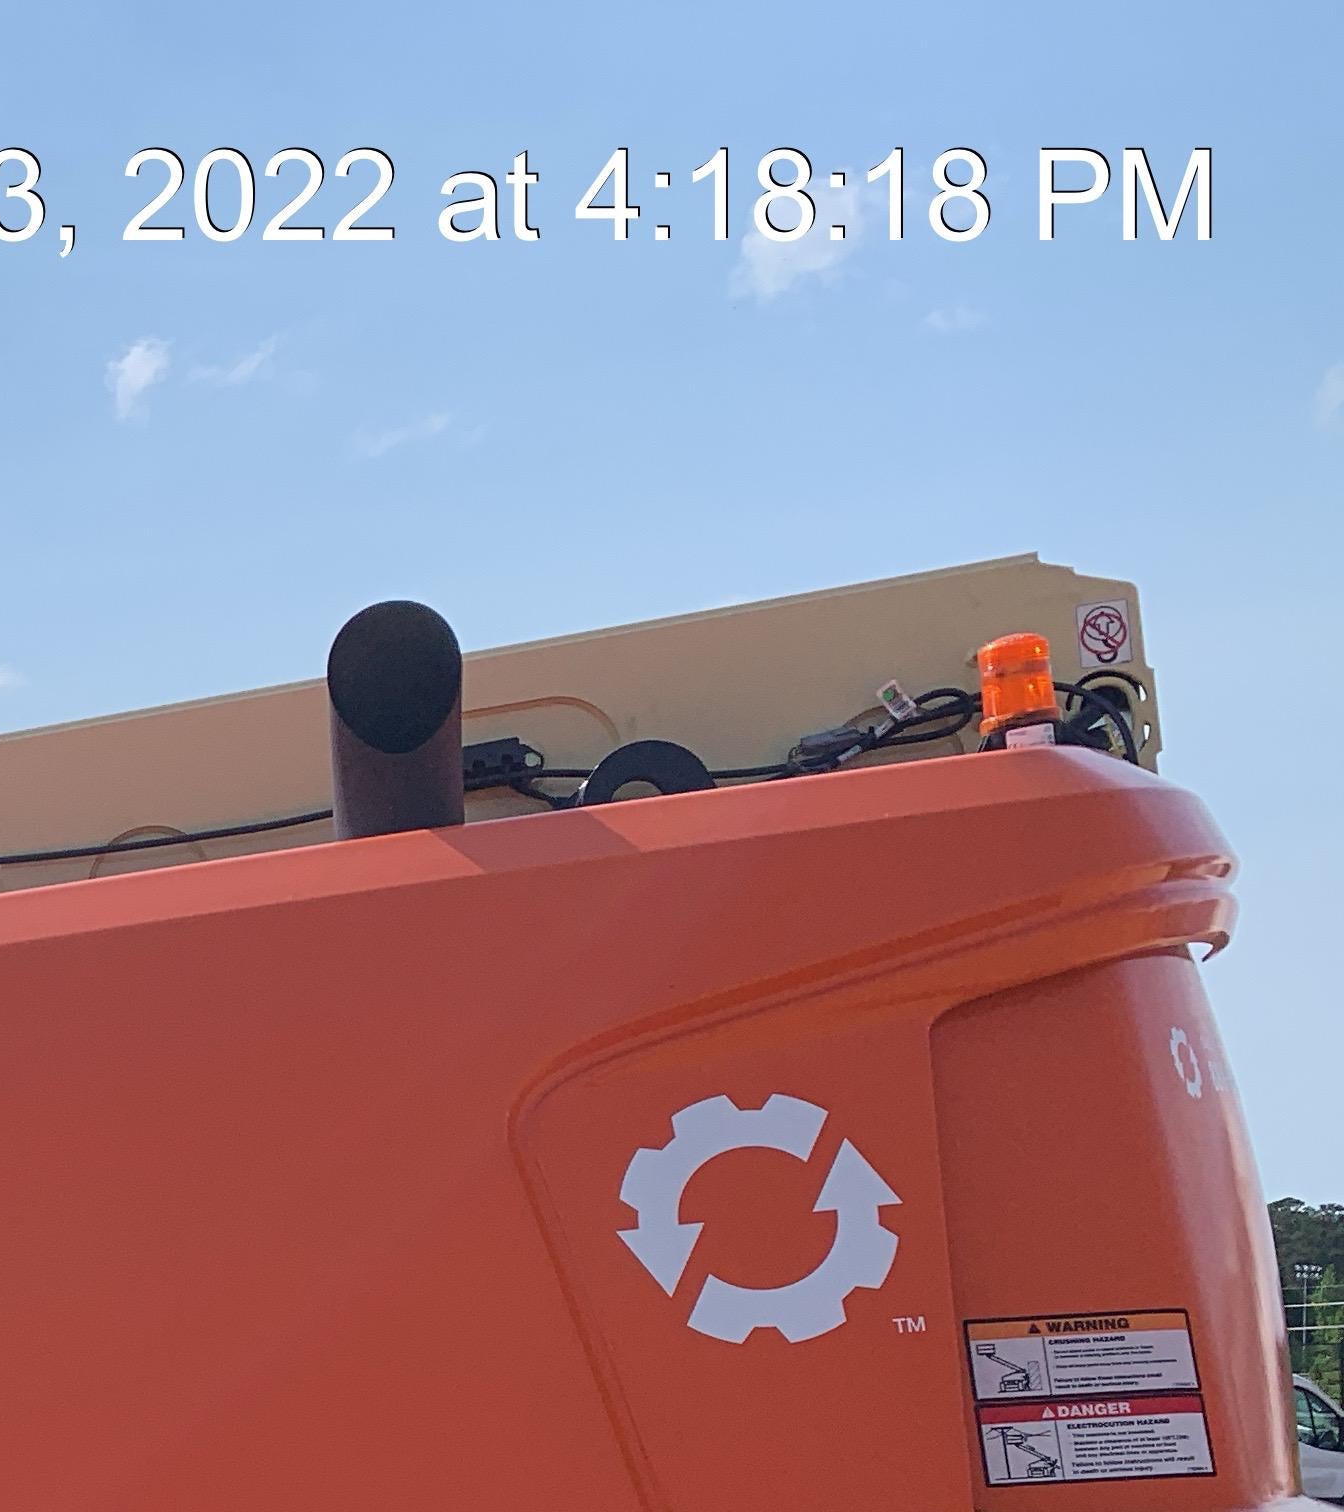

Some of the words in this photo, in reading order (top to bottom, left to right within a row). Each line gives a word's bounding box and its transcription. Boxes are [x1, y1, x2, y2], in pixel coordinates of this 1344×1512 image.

[892, 1315, 926, 1334] TM
[1045, 1317, 1130, 1333] WARNING
[1048, 1338, 1091, 1346] CRUSHING
[1092, 1335, 1126, 1343] HAZARD
[1057, 1402, 1131, 1418] DANGER
[1067, 1420, 1134, 1430] ELECTROCUTION
[1137, 1418, 1170, 1426] HAZARD
